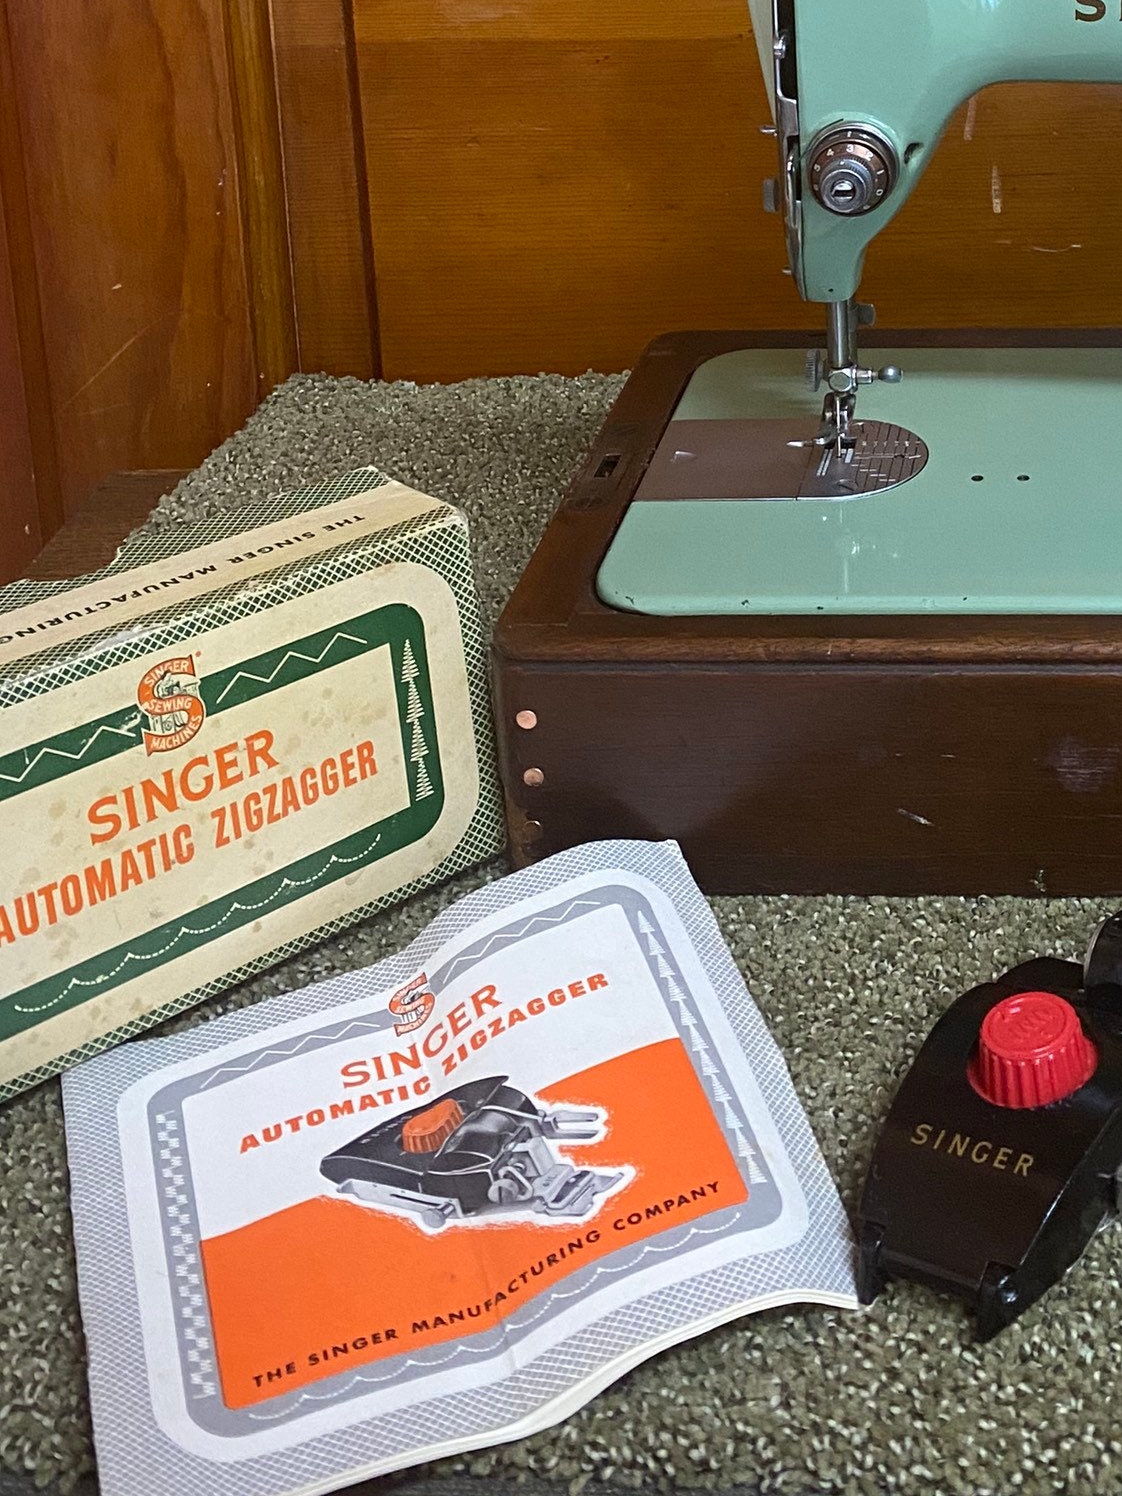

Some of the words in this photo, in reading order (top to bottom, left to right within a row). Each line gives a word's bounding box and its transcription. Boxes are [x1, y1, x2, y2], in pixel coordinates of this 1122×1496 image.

[826, 148, 835, 157] 4
[846, 144, 854, 153] 3
[865, 151, 874, 161] 2
[322, 514, 365, 532] THE
[227, 531, 317, 564] SINGER
[0, 564, 217, 645] MANUFACTURING
[144, 660, 189, 686] SINGER
[148, 697, 192, 713] SEWING
[151, 715, 202, 749] MACHINES
[87, 729, 279, 845] SINGER
[0, 823, 195, 948] AUTOMATIC
[210, 740, 378, 849] ZIGZAGGER
[340, 984, 502, 1088] SINGER
[240, 1077, 431, 1153] AUTOMATIC
[441, 973, 609, 1075] ZIGZAGGER
[910, 1123, 1034, 1177] SINGER
[253, 1362, 297, 1388] THE
[308, 1328, 399, 1366] SINGER
[411, 1229, 601, 1334] MANUFACTURING
[612, 1181, 721, 1231] COMPANY
